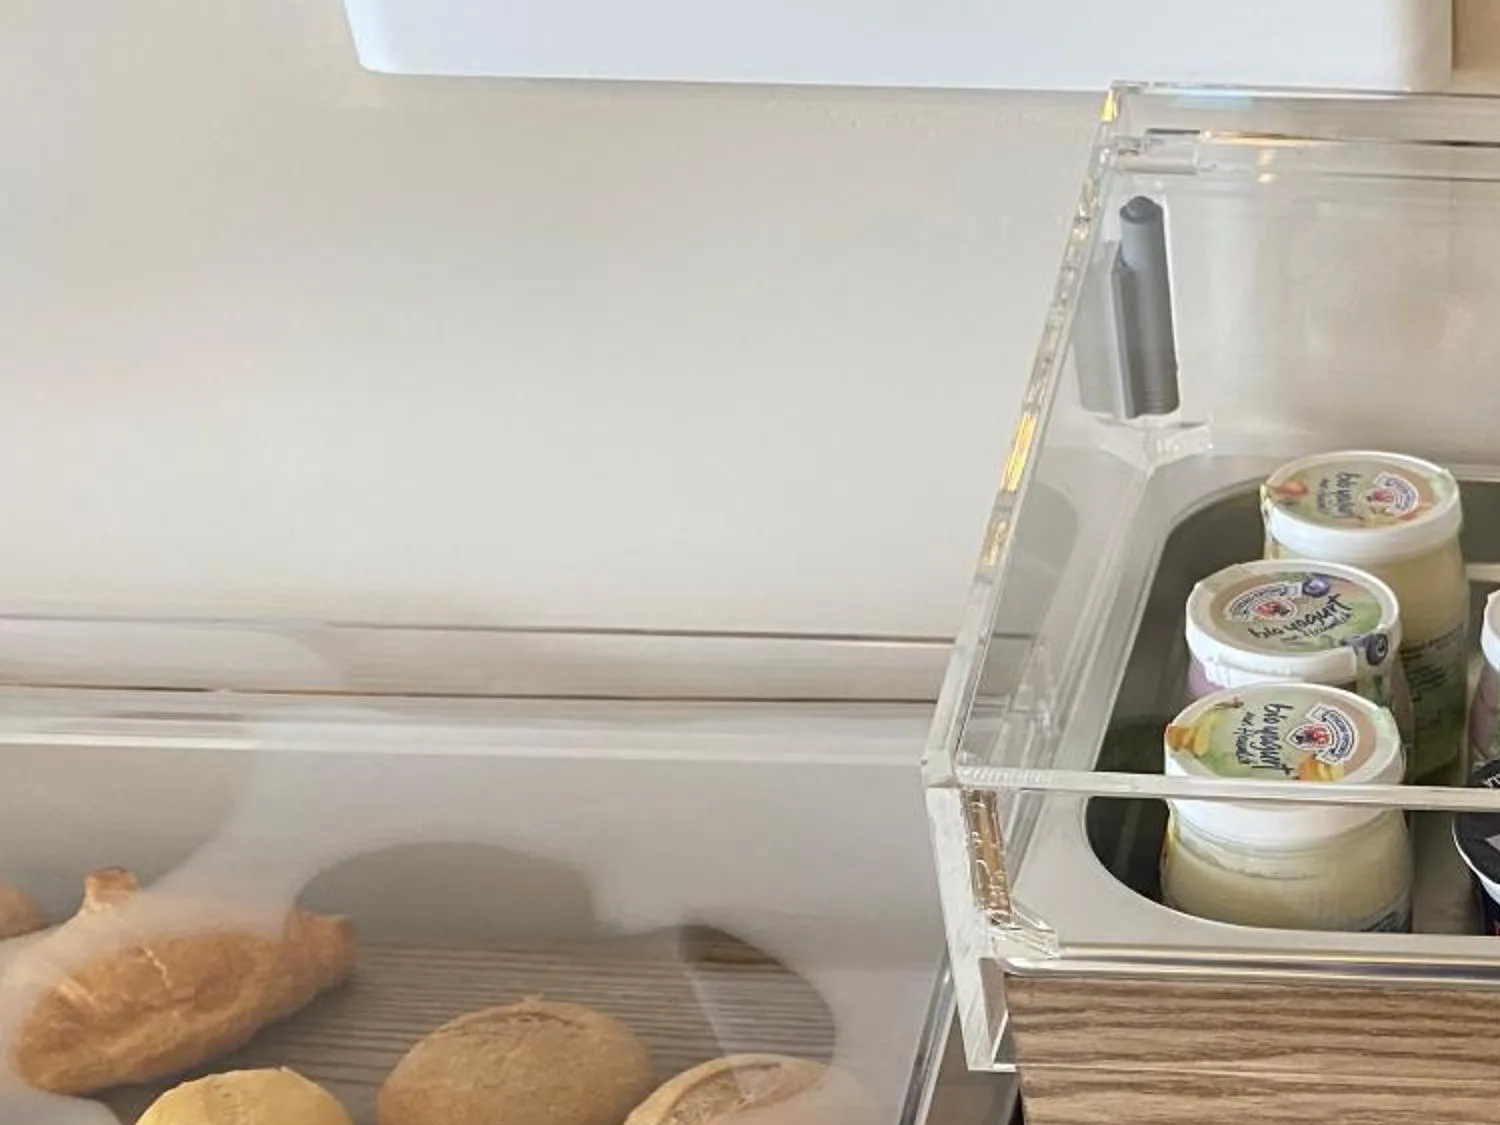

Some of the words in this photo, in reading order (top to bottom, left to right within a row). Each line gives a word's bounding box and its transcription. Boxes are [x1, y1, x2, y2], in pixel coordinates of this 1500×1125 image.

[1248, 626, 1284, 640] bio
[1286, 592, 1353, 637] yogurt
[1263, 703, 1295, 725] bio
[1250, 725, 1295, 776] yogurt
